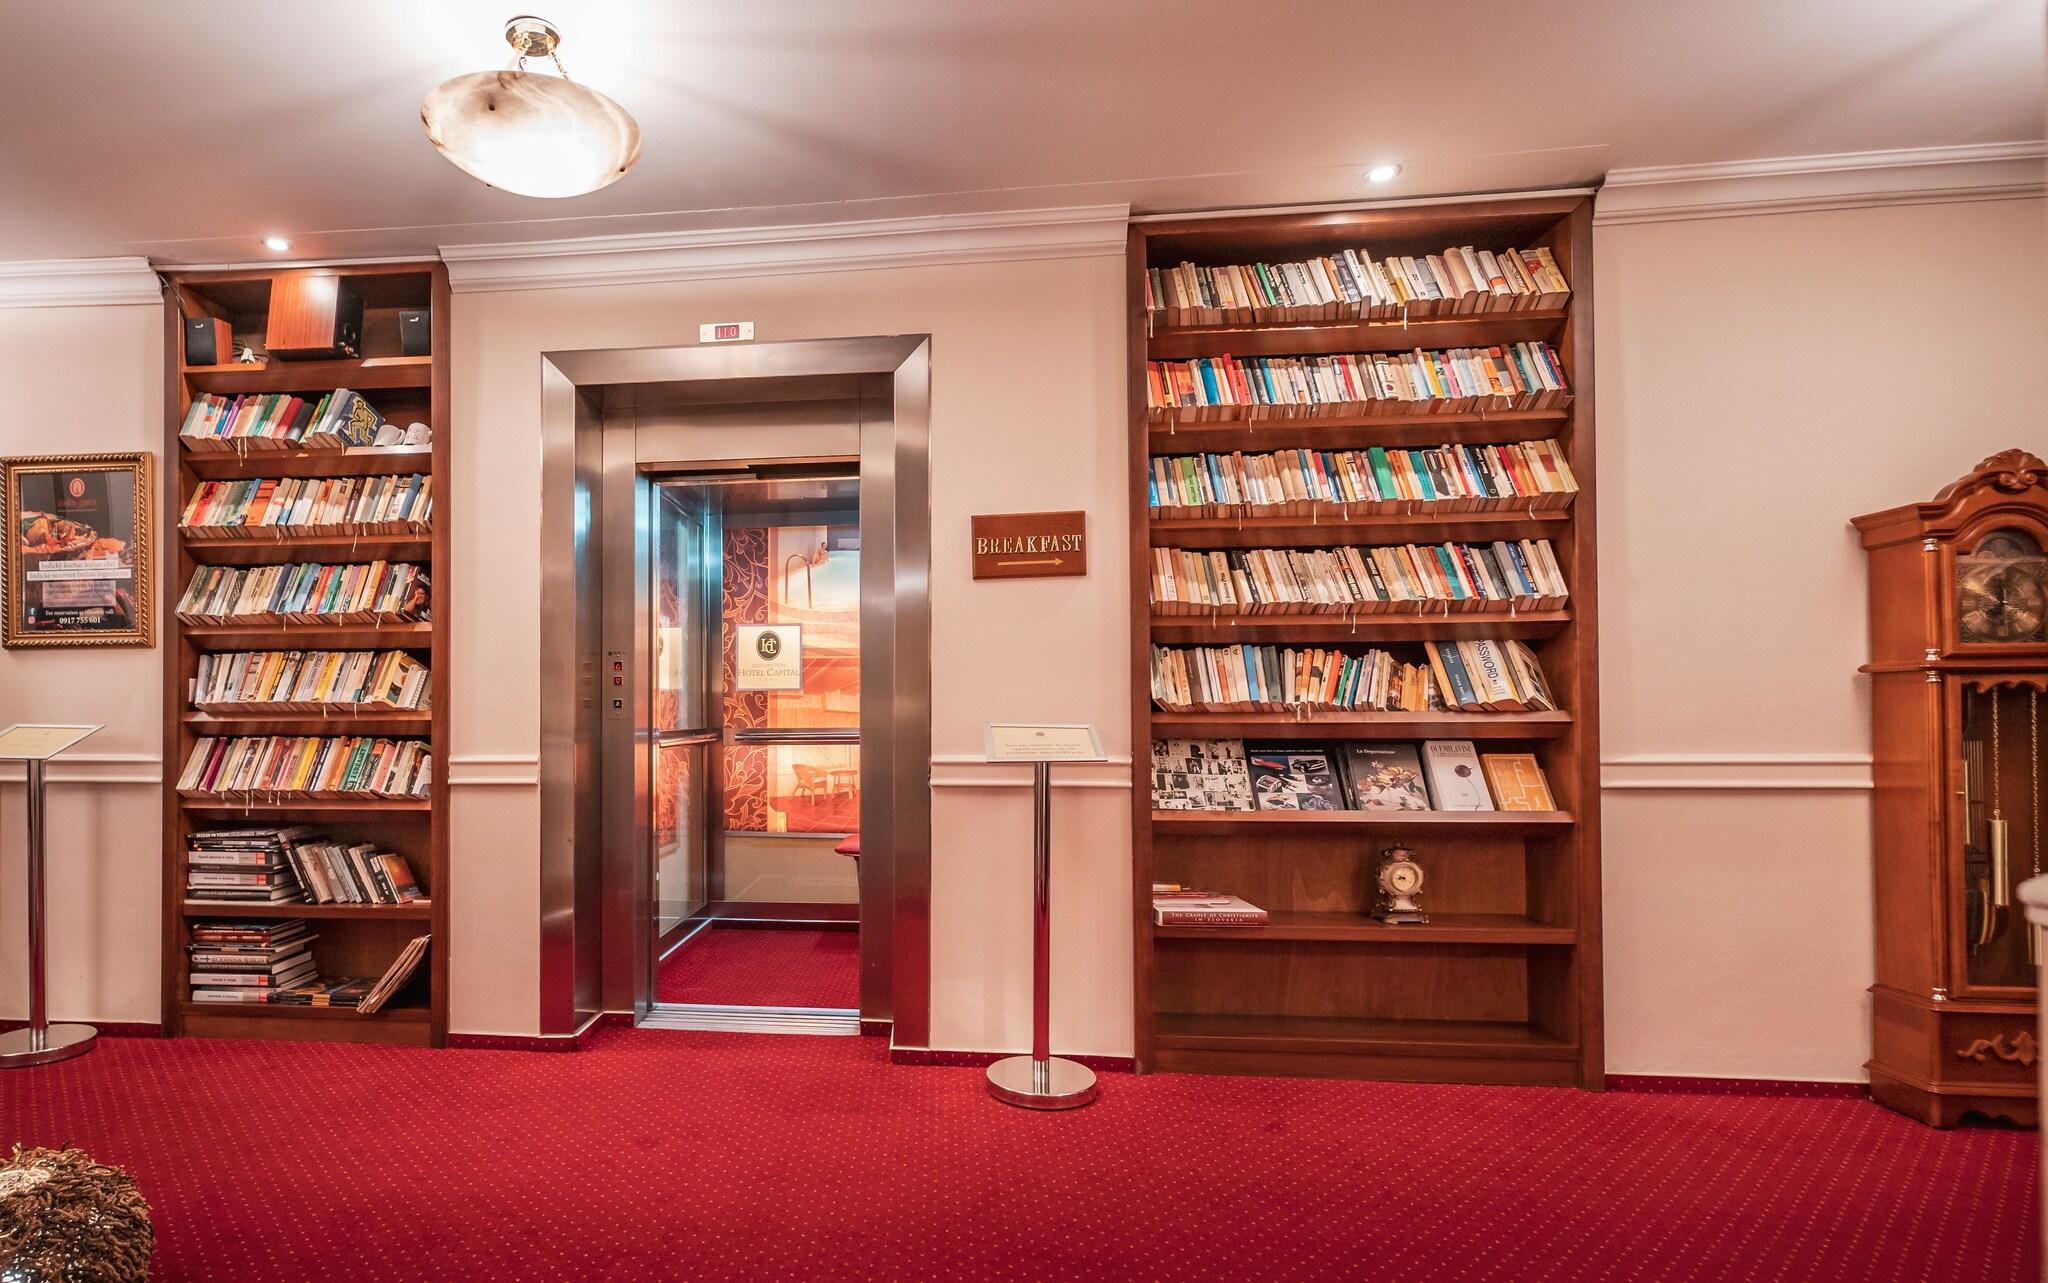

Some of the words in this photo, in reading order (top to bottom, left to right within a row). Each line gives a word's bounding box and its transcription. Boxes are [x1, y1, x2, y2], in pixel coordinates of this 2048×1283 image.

[976, 534, 1082, 555] BREAKFAST
[738, 668, 765, 677] HOTEL
[766, 668, 800, 677] CAPITAL
